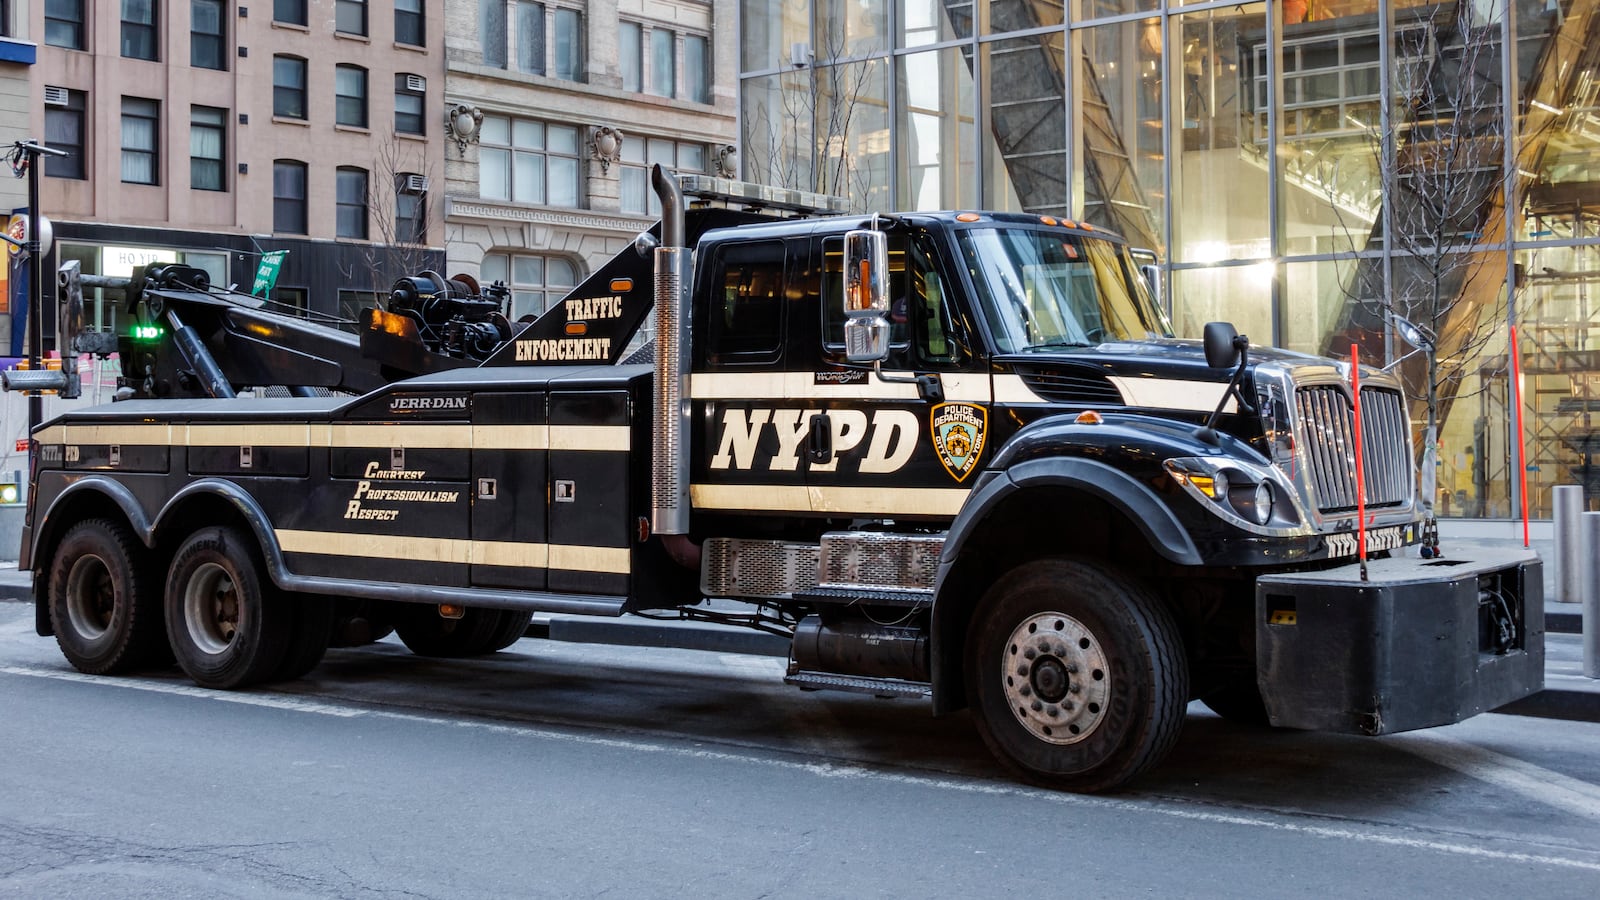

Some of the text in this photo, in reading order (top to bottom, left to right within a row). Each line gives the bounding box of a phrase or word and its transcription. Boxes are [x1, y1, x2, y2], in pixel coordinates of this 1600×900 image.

[119, 252, 135, 264] HO
[565, 296, 622, 321] TRAFFIC
[515, 338, 611, 361] ENFORCEMENT
[934, 413, 983, 429] DEPARTMENT
[944, 405, 974, 415] POLICE
[710, 409, 920, 474] NYPD
[935, 435, 954, 467] CITY OF
[962, 432, 984, 472] NEW YORK
[1325, 526, 1403, 559] NYPD RAFFIC
